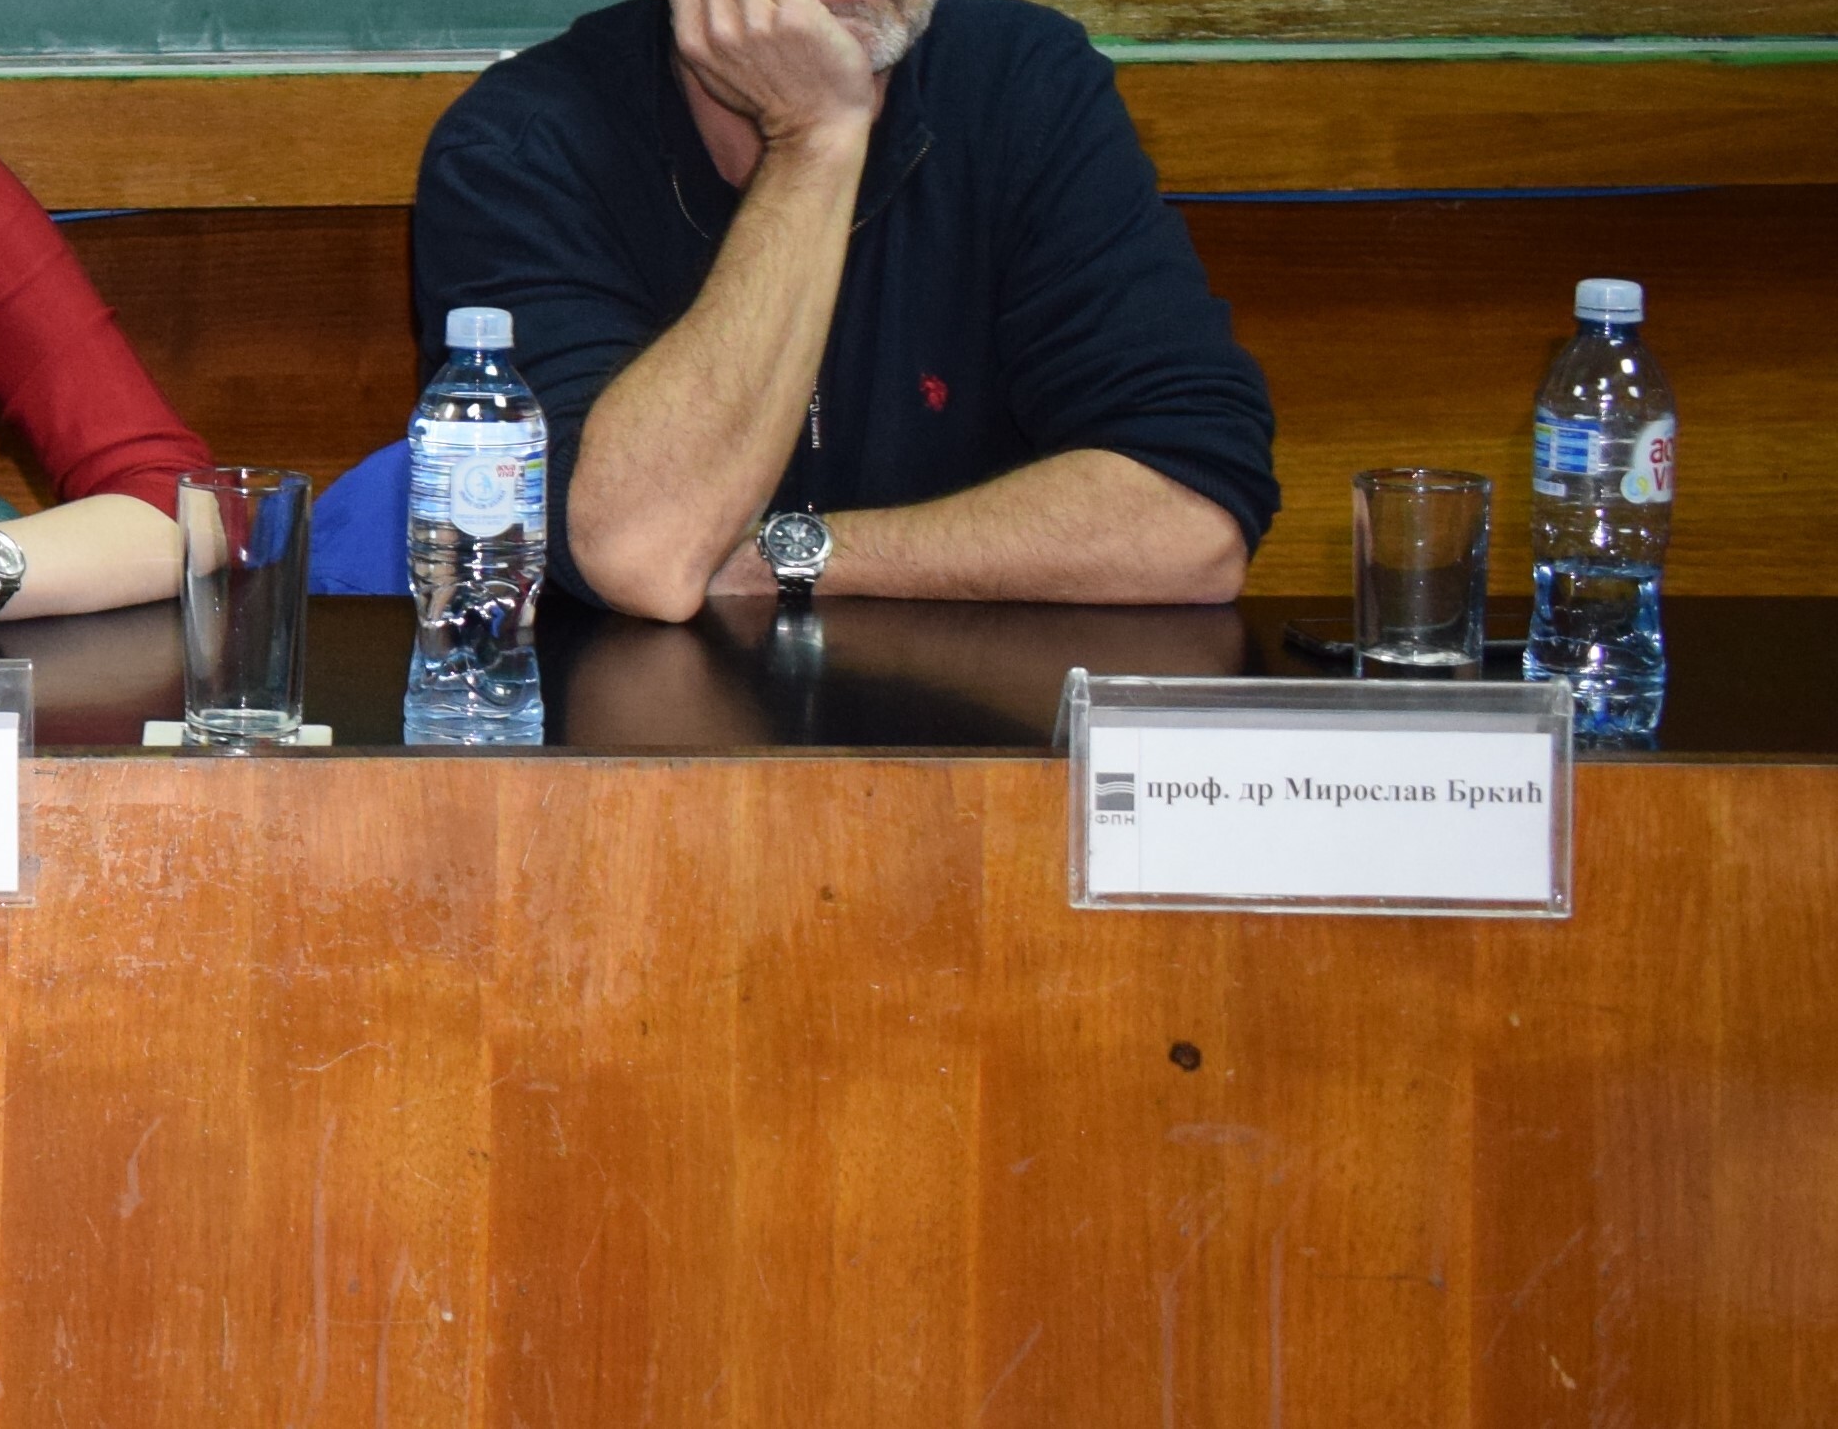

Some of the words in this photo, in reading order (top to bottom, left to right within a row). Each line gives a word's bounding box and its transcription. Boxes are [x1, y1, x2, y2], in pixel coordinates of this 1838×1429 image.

[1148, 777, 1229, 805] проф.
[1240, 784, 1273, 806] др
[1286, 778, 1436, 807] Мирослав
[1449, 780, 1542, 809] Бркић
[1095, 813, 1135, 825] ФПН
